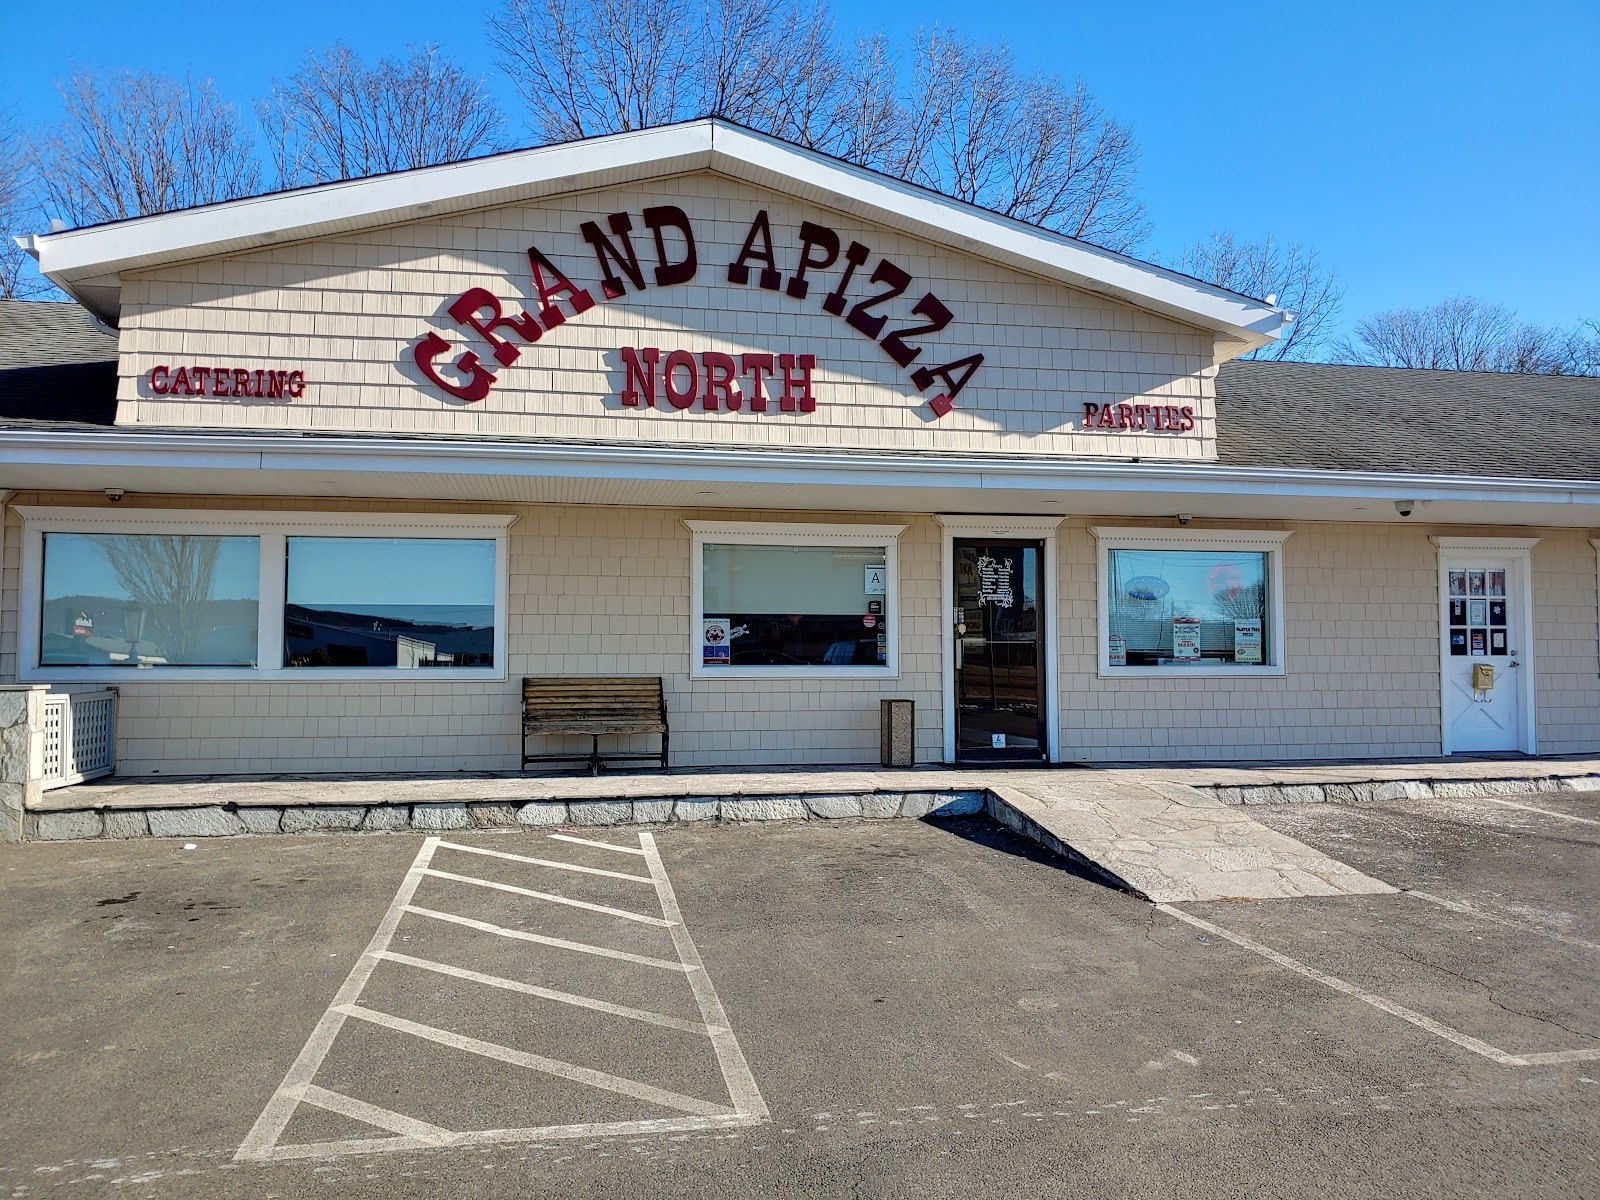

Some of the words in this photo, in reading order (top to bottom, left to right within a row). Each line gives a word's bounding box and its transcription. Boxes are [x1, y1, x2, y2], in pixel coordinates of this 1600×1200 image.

[414, 206, 697, 402] GRAND
[728, 210, 984, 418] APIZZA
[152, 365, 306, 398] CATERING
[622, 347, 816, 412] NORTH
[1083, 402, 1195, 432] PARTIES
[871, 572, 880, 583] A
